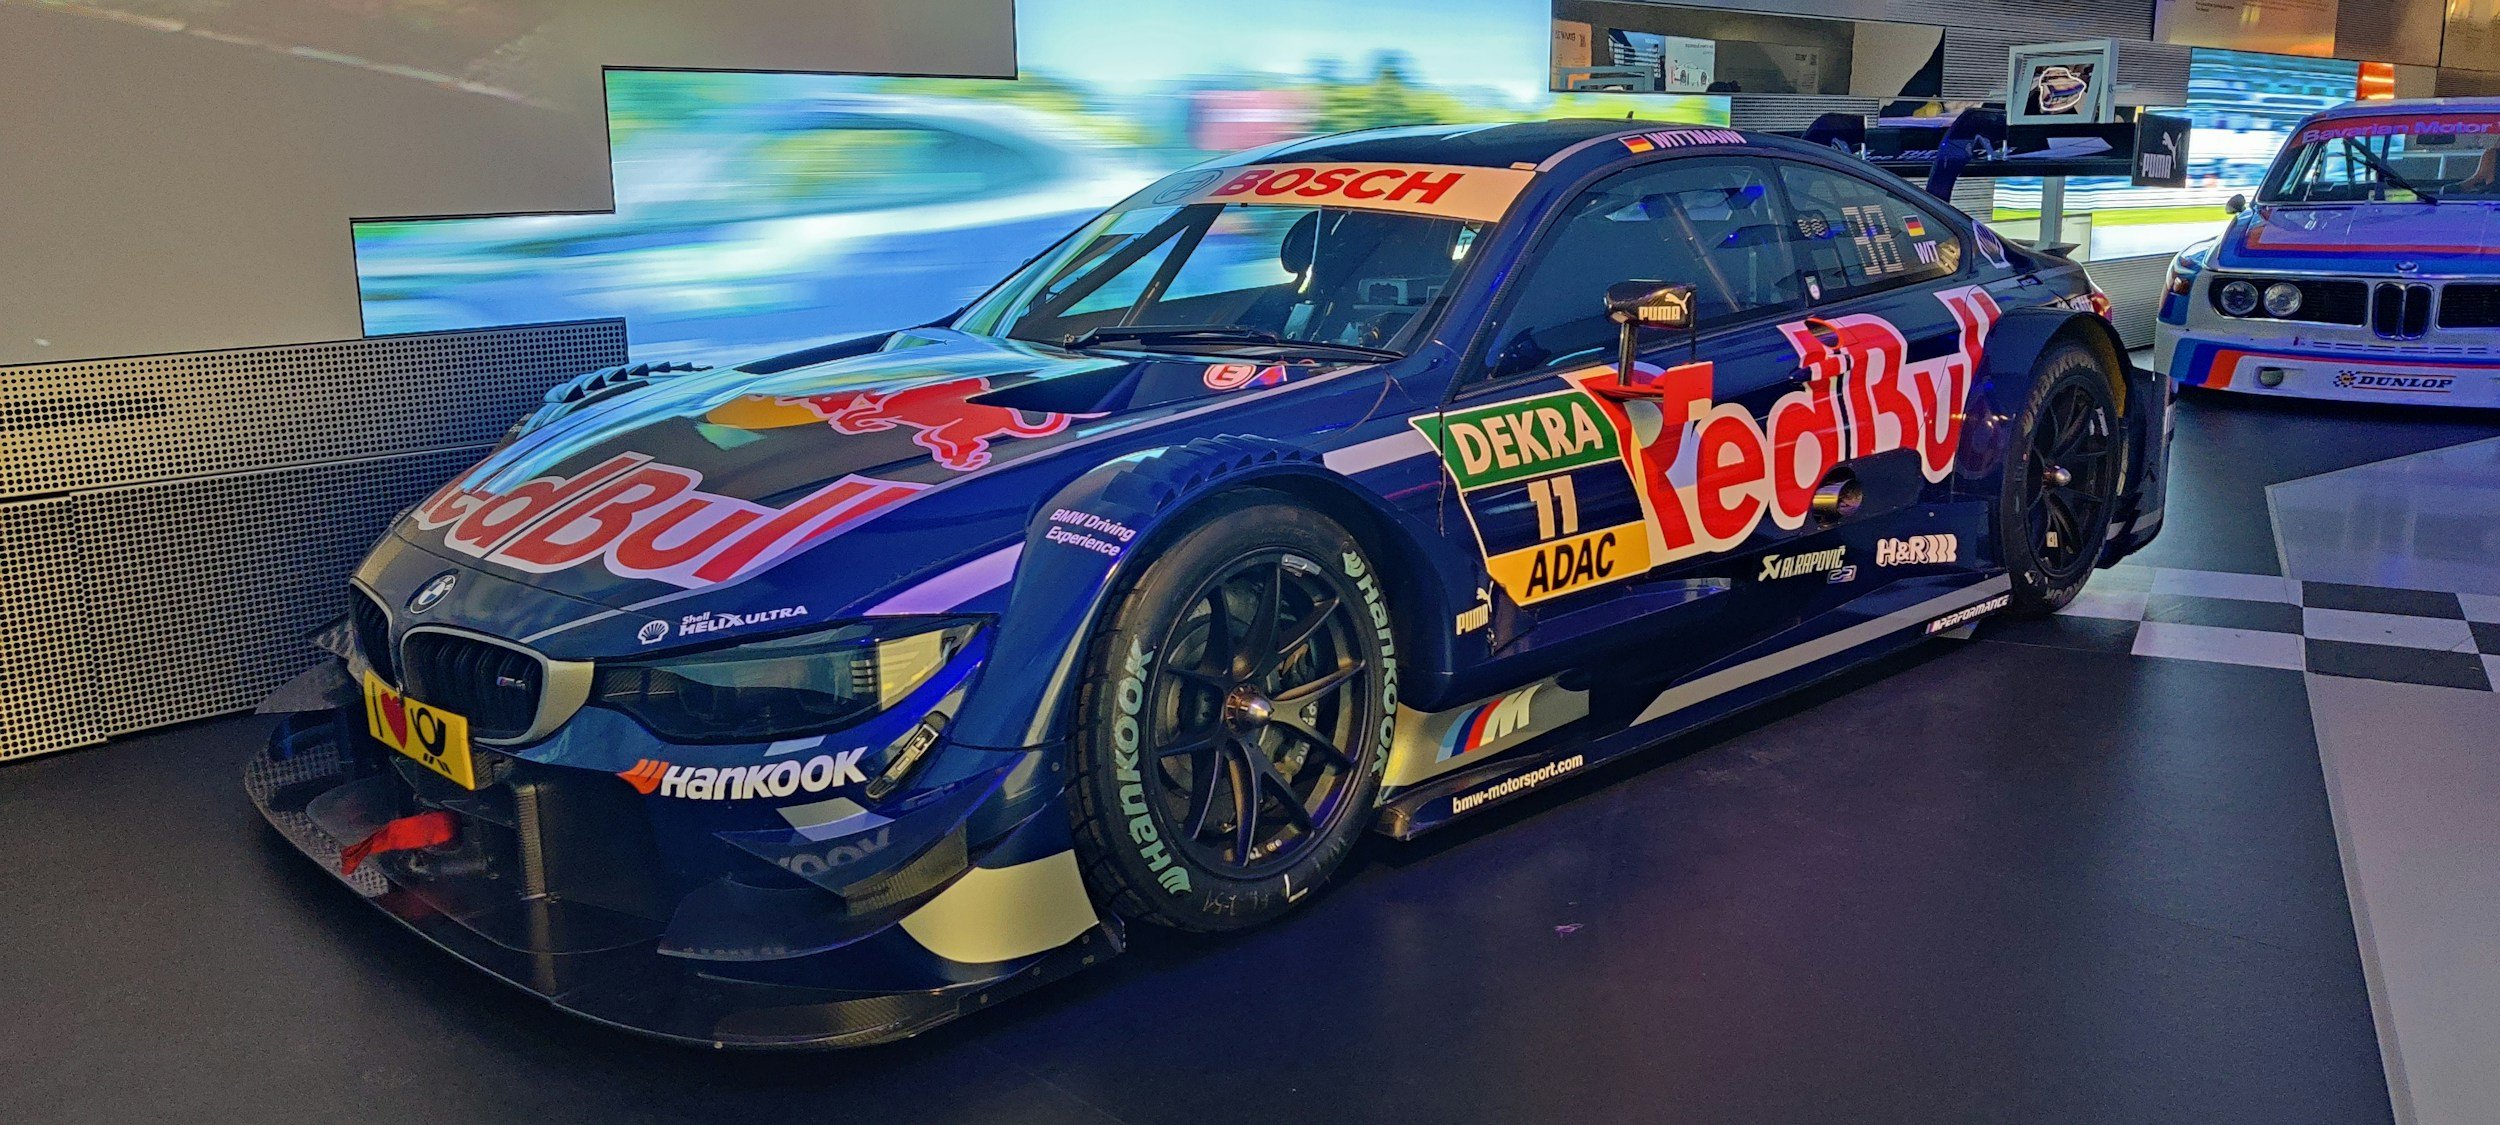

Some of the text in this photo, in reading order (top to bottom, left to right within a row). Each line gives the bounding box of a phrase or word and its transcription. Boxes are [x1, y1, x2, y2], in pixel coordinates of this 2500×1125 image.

[1644, 129, 1748, 149] WITTMANN
[2302, 123, 2409, 144] Bavarian
[2414, 120, 2492, 134] Motor
[2141, 152, 2172, 179] PUMA
[1210, 167, 1466, 204] BOSCH
[1913, 240, 1940, 265] WIT
[1637, 304, 1682, 323] PUMA
[2357, 375, 2454, 389] DUNLOP
[1572, 288, 2002, 552] RedBul
[1449, 401, 1604, 476] DEKRA
[415, 452, 925, 585] edBull
[1530, 475, 1579, 540] 11
[1045, 526, 1121, 557] Experience
[1049, 508, 1137, 543] BMW Driving
[1525, 532, 1617, 598] ADAC
[678, 605, 808, 637] HELIX ULTRA
[682, 611, 711, 626] Shell
[1456, 604, 1489, 636] PUMA
[1452, 753, 1584, 814] bmw-motorsport.com
